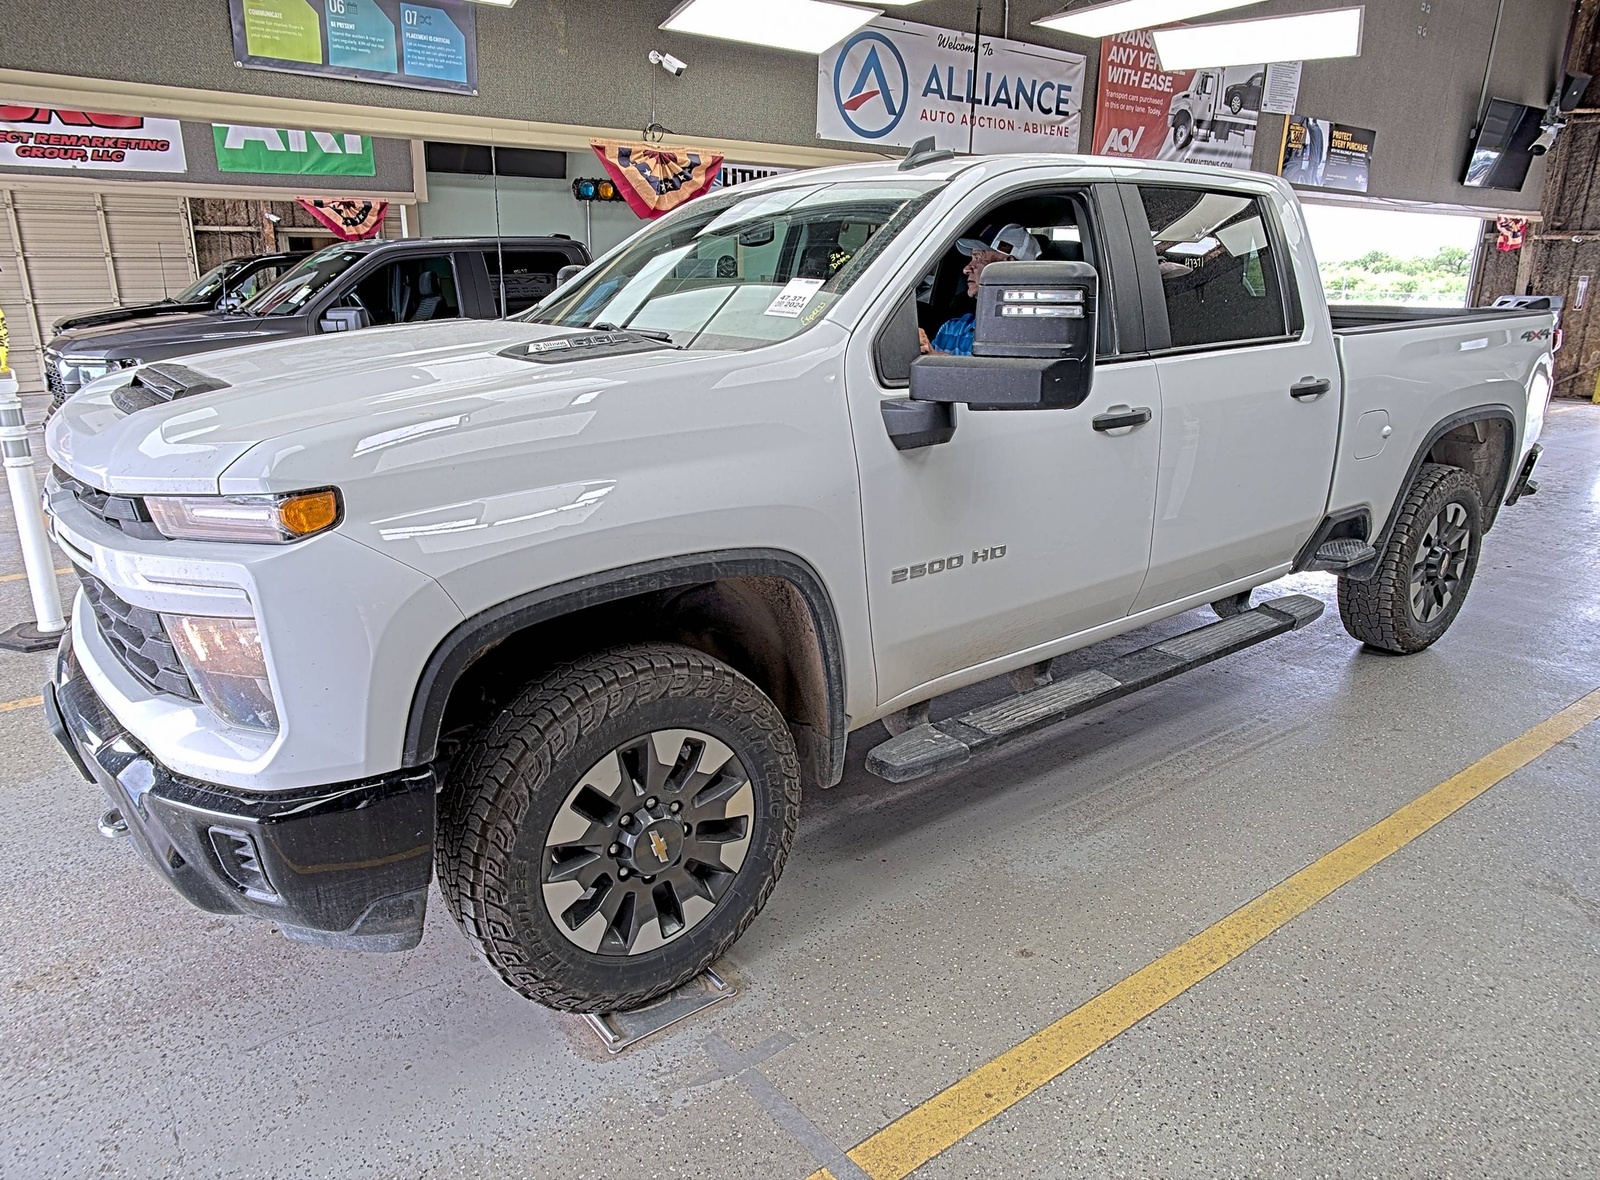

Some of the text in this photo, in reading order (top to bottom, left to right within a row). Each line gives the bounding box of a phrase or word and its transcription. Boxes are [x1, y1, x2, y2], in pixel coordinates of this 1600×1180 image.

[329, 0, 345, 14] 06
[405, 9, 418, 25] 07
[336, 22, 355, 30] PRESENT
[937, 33, 994, 56] Welcom To
[1107, 45, 1138, 66] ANY
[1107, 65, 1174, 93] WITH EASE.
[921, 63, 1072, 117] ALLIANCE
[1105, 89, 1164, 105] Transport cars purchased
[1109, 101, 1120, 109] this
[1126, 104, 1135, 113] any
[1135, 105, 1147, 113] lane.
[1147, 106, 1162, 116] Today.
[920, 108, 955, 124] AUTO
[960, 113, 1015, 132] AUCTION
[1023, 122, 1070, 138] ABILENE
[34, 133, 170, 151] REMARKETING
[1100, 126, 1145, 155] ACV
[1331, 139, 1346, 149] EVERY
[1332, 130, 1352, 141] PROTECT
[16, 146, 125, 163] GROUP, LLC
[722, 167, 778, 187] LITH
[783, 301, 805, 309] 2024
[891, 544, 1007, 585] 2500 HD
